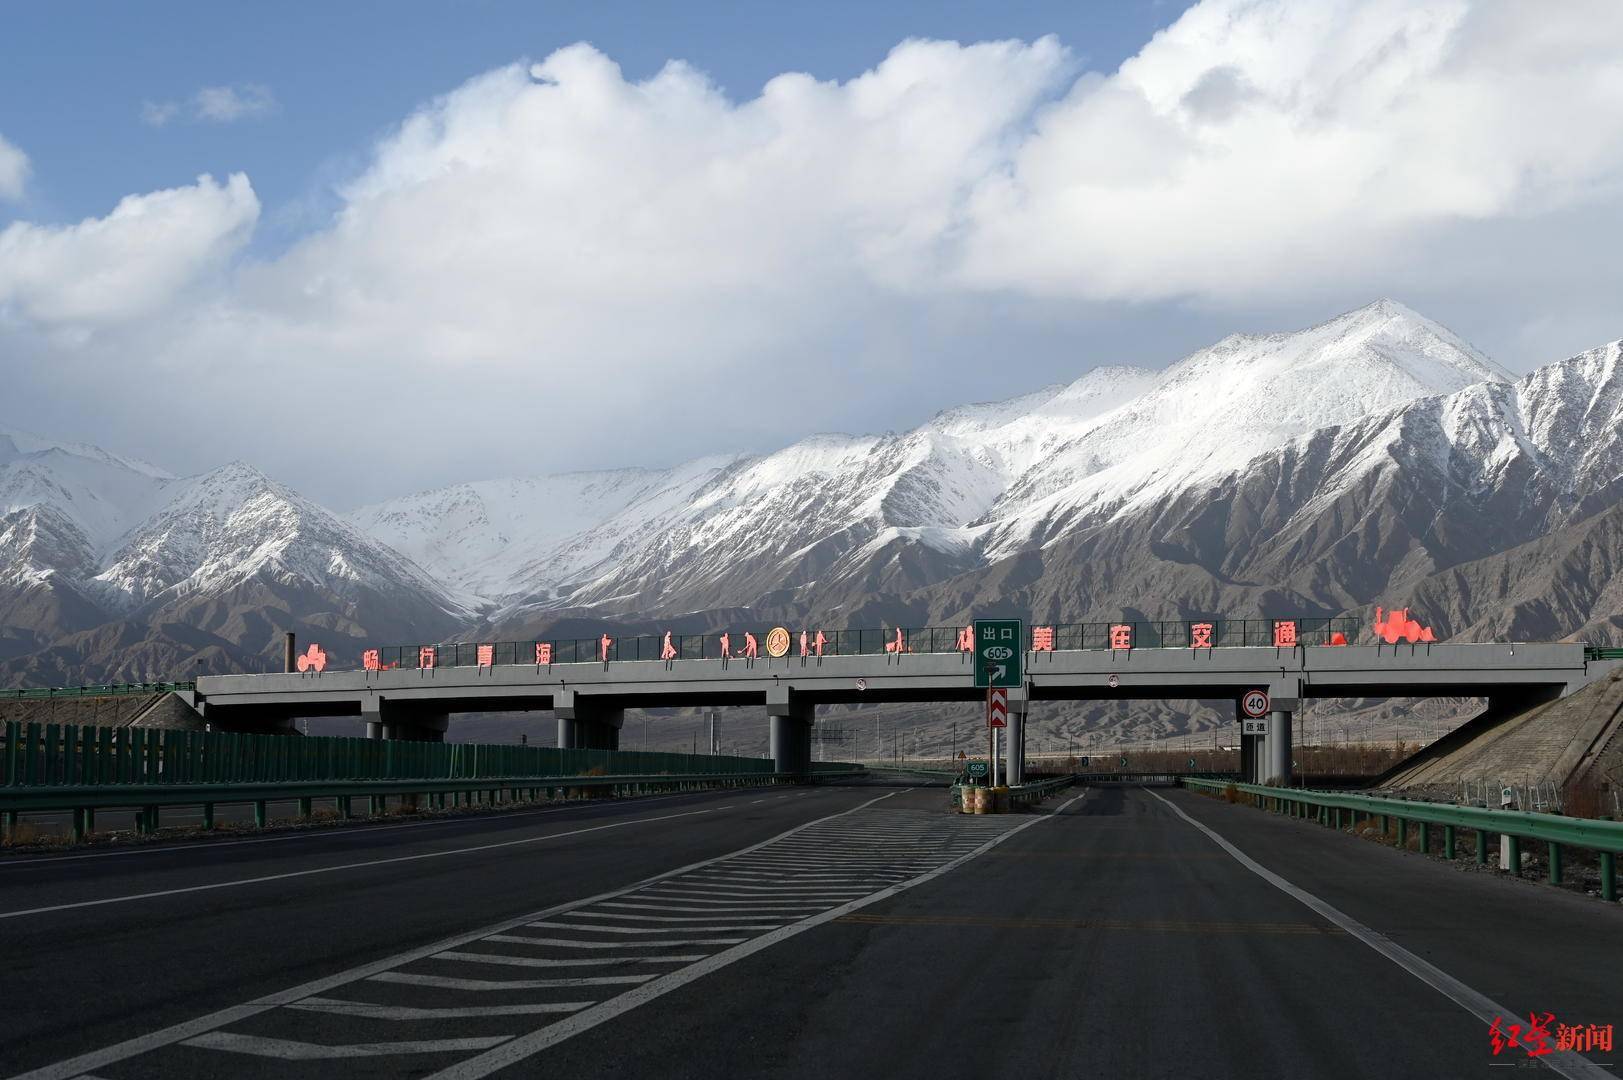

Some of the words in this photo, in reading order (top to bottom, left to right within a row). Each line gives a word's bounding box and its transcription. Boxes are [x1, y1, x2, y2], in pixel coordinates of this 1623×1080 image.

[983, 627, 1012, 640] 出口
[1032, 621, 1296, 650] 美在交通
[987, 647, 1008, 658] 605
[1248, 697, 1264, 709] 40
